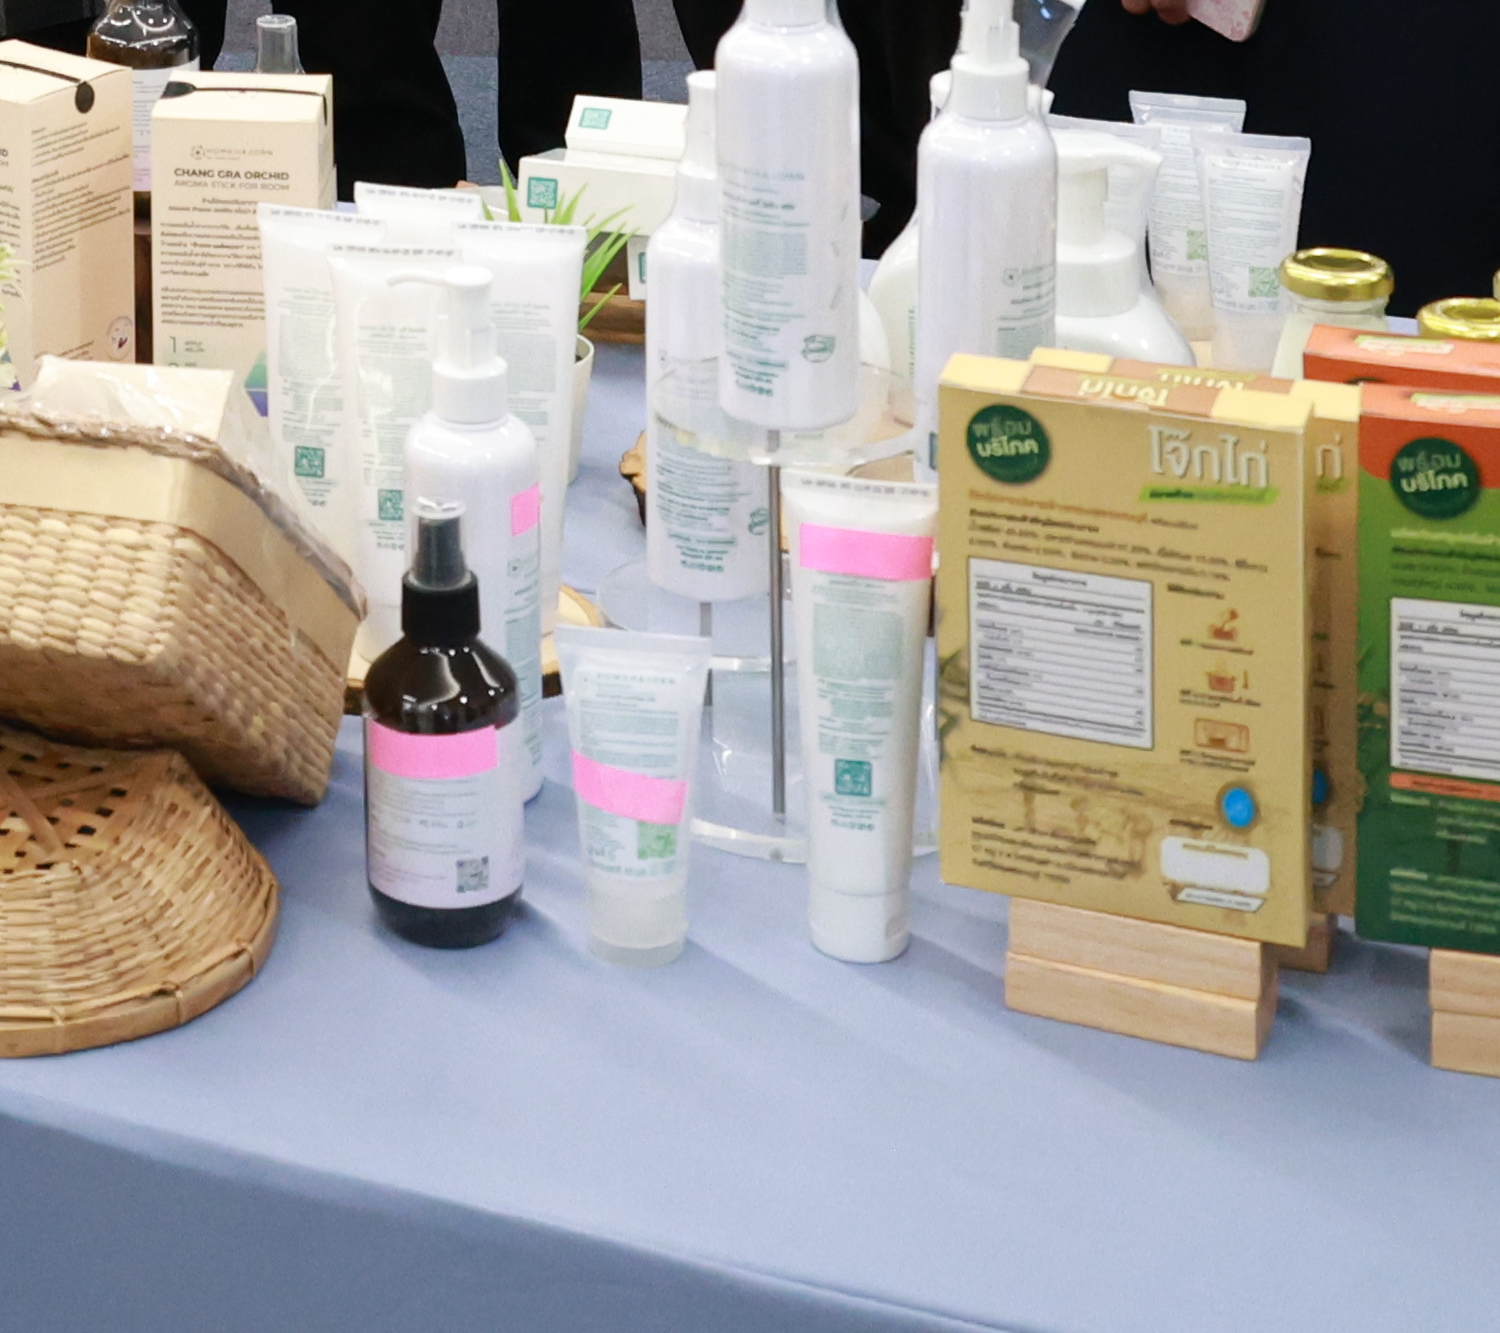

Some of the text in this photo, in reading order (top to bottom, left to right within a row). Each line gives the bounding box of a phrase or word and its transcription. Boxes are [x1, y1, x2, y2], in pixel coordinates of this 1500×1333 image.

[174, 167, 290, 182] CHANG GRA ORCHID
[260, 182, 290, 192] ROOM
[976, 435, 1039, 458] บริโภค
[1146, 424, 1269, 488] โจ๊กไก่
[1397, 449, 1462, 472] พร้อม
[1400, 468, 1469, 493] บริโภค
